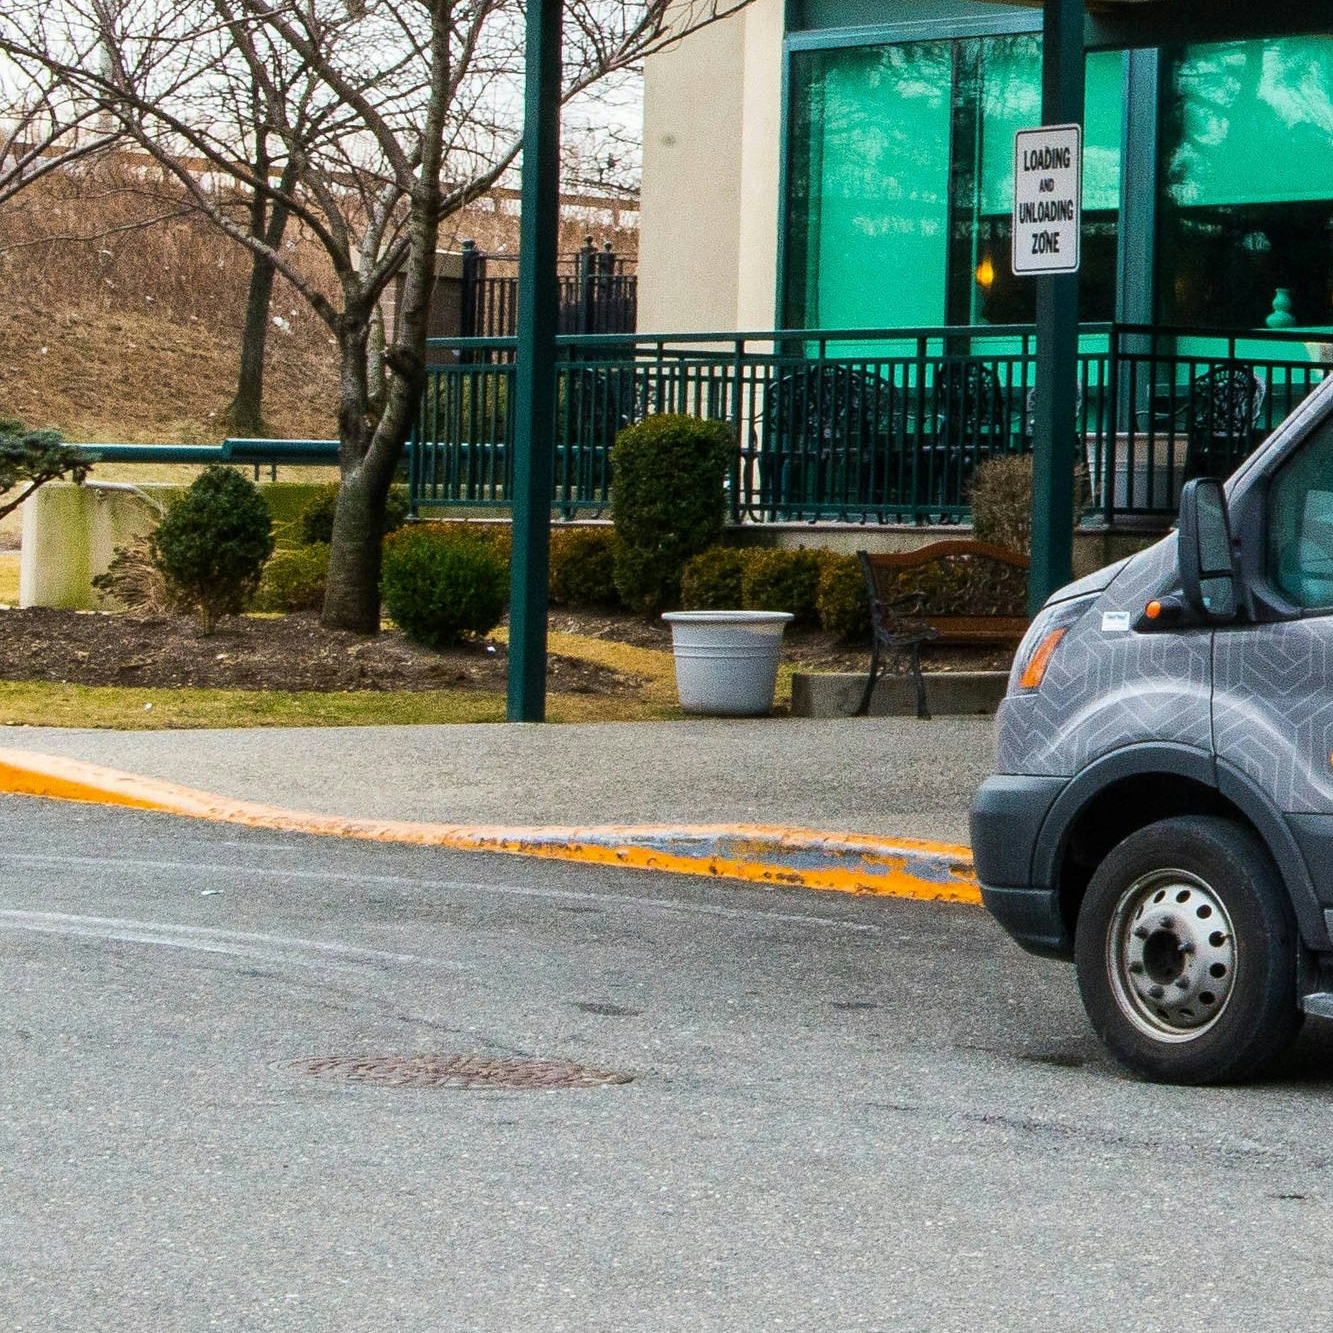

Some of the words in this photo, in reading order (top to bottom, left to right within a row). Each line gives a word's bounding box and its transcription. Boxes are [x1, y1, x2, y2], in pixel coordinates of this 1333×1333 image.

[1023, 146, 1071, 172] LOADING
[1039, 177, 1055, 193] AND
[1018, 199, 1074, 225] UNLOADING
[1031, 230, 1061, 255] ZONE
